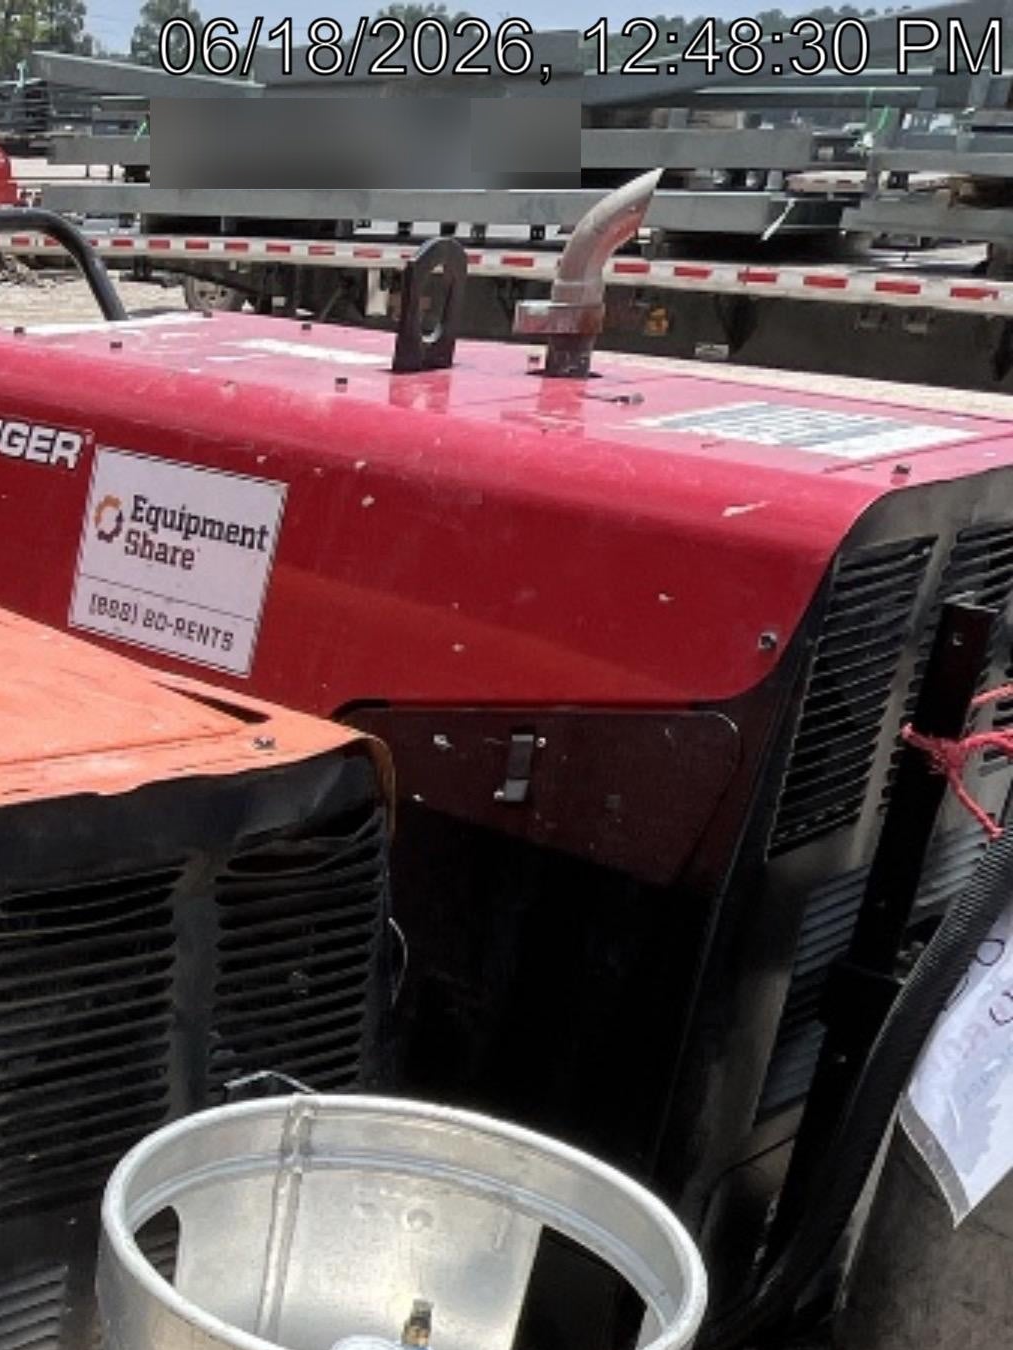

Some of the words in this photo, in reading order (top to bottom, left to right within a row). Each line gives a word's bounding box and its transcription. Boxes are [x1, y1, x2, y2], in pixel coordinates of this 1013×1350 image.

[130, 494, 269, 552] Equipment
[124, 528, 196, 571] Share
[89, 593, 138, 625] (888)
